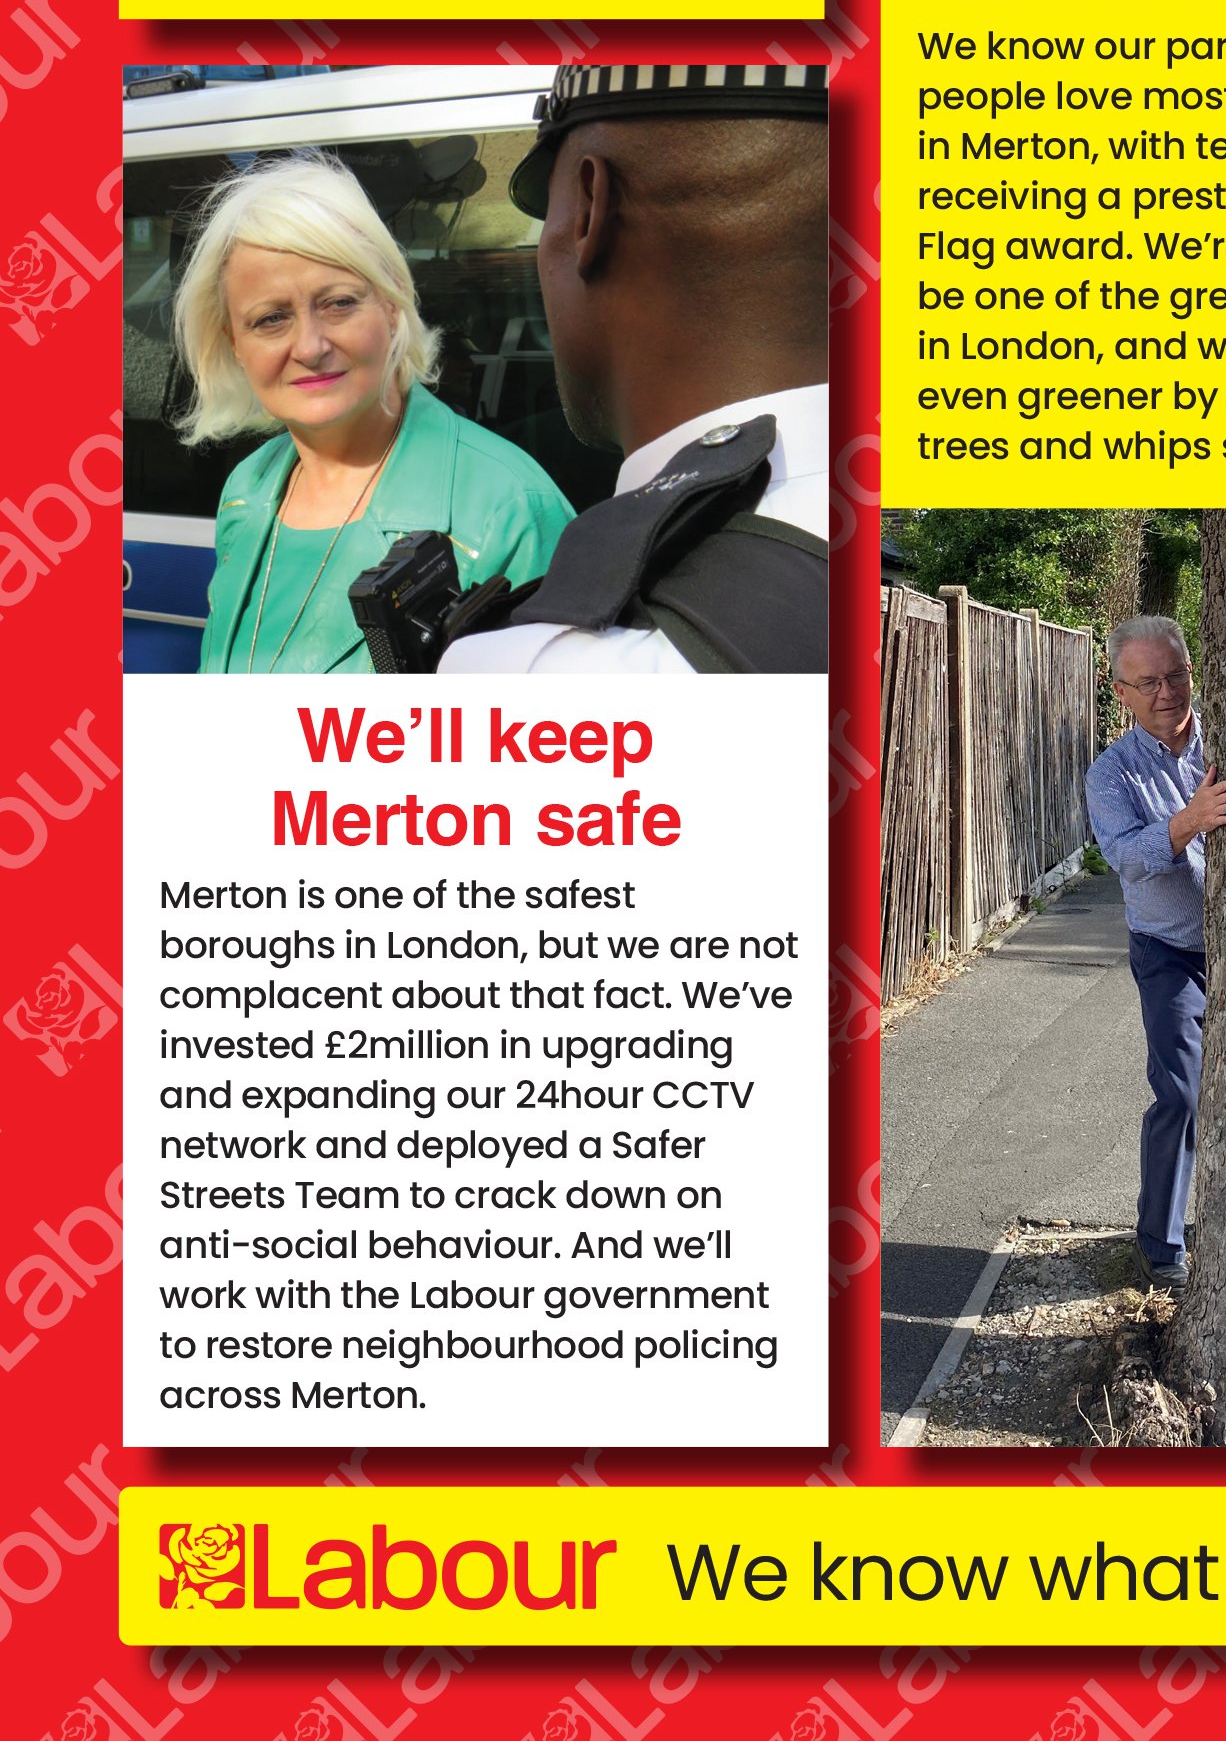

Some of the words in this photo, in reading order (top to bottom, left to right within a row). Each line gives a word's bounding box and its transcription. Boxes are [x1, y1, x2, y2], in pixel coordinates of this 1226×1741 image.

[918, 388, 1006, 409] even
[1018, 388, 1162, 419] greener
[1174, 381, 1218, 419] by
[918, 433, 1008, 460] trees
[1020, 431, 1091, 460] and
[1104, 430, 1210, 469] whips
[490, 708, 652, 778] keep
[274, 791, 510, 846] Merton
[537, 790, 681, 846] safe
[160, 1080, 231, 1109] and
[242, 1079, 435, 1119] expanding
[447, 1087, 506, 1109] our
[517, 1080, 644, 1109] 24hour
[653, 1081, 754, 1109] CCTV
[253, 1523, 618, 1611] Labour
[667, 1544, 787, 1601] We
[814, 1541, 1009, 1601] know
[1029, 1541, 1219, 1601] what
